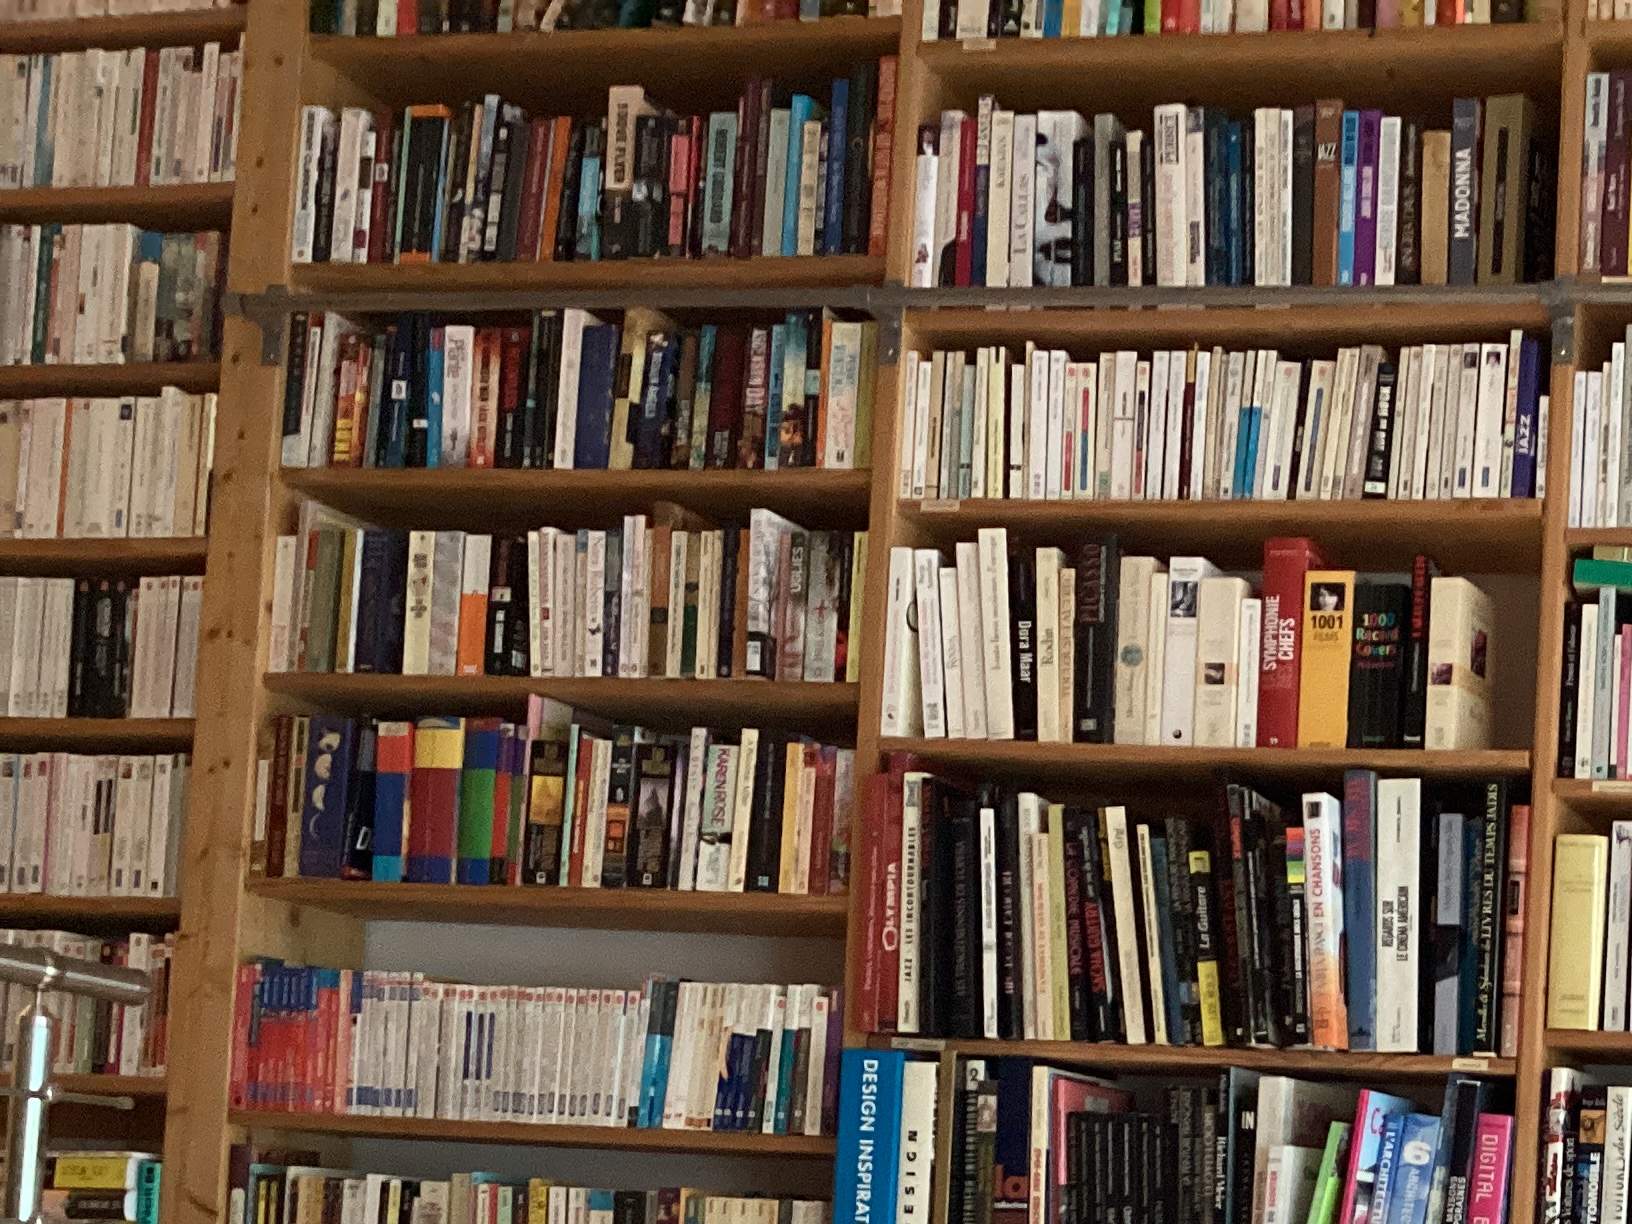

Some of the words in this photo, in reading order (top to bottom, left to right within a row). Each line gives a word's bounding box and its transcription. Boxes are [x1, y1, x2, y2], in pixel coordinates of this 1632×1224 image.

[1454, 147, 1472, 239] MADONNA
[1516, 413, 1533, 455] JAZZ
[1080, 544, 1101, 622] PICASSO
[1018, 621, 1032, 648] Dora
[1262, 595, 1280, 671] SYMPHONIE
[1279, 617, 1295, 660] CHEFS
[1310, 615, 1343, 629] 1001
[1362, 613, 1396, 627] 1000
[1040, 627, 1054, 666] Rodin
[1355, 642, 1398, 657] Covers
[1017, 652, 1032, 683] Maar
[715, 748, 731, 790] KAREN
[711, 789, 727, 828] ROSE
[1485, 784, 1498, 820] JADIS
[1309, 828, 1324, 897] CHANSONS
[1483, 822, 1497, 865] TEMPS
[906, 826, 916, 924] INCONTOURNABLES
[1482, 870, 1495, 890] DU
[881, 862, 899, 951] OLYMPIA
[1197, 886, 1209, 931] Guitare
[1313, 902, 1325, 917] EN
[1481, 893, 1494, 939] LIVRES
[1198, 933, 1210, 948] La
[903, 958, 913, 982] JAZZ
[860, 1059, 879, 1131] DESIGN
[1474, 1133, 1498, 1202] DIGITAL
[1565, 1136, 1577, 1162] sport
[1563, 1165, 1573, 1177] de
[1446, 1175, 1457, 1223] MAISONS
[1561, 1179, 1573, 1216] Voitures
